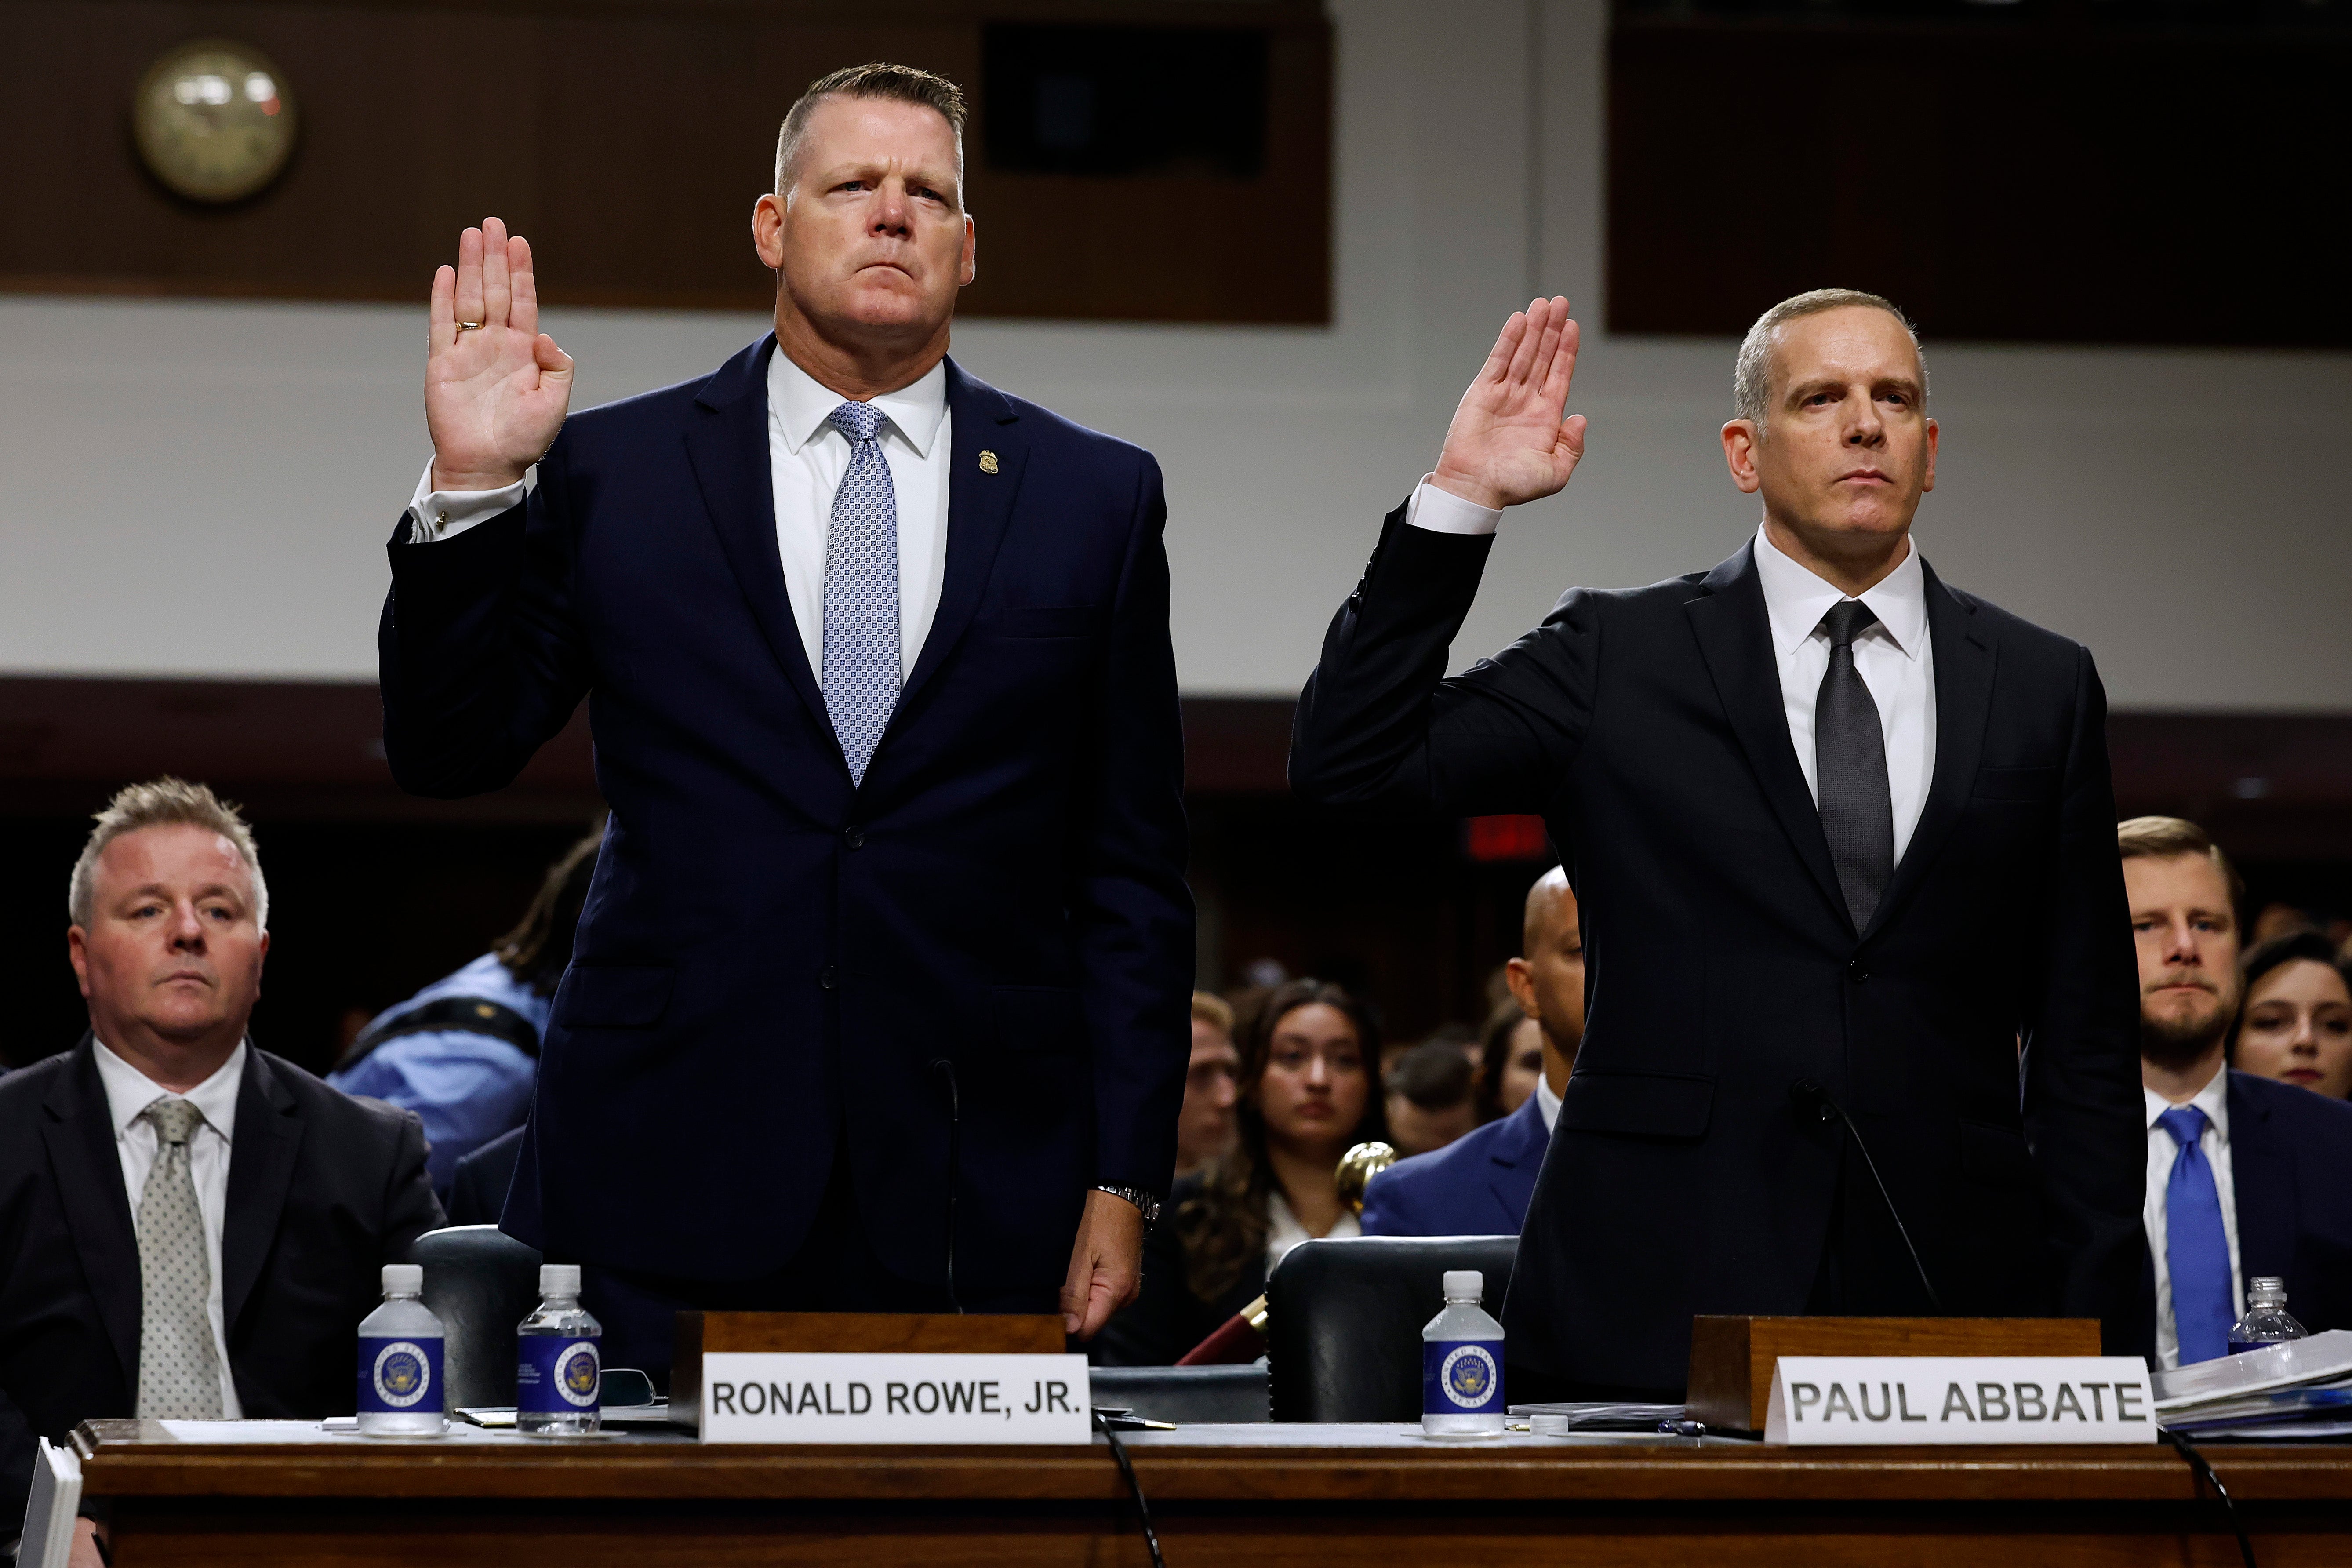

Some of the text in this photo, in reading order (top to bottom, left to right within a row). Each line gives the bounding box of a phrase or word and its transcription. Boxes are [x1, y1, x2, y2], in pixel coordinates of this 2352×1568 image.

[712, 1381, 1079, 1419] RONALD ROWE, JR.
[1791, 1382, 2146, 1422] PAUL ABBATE
